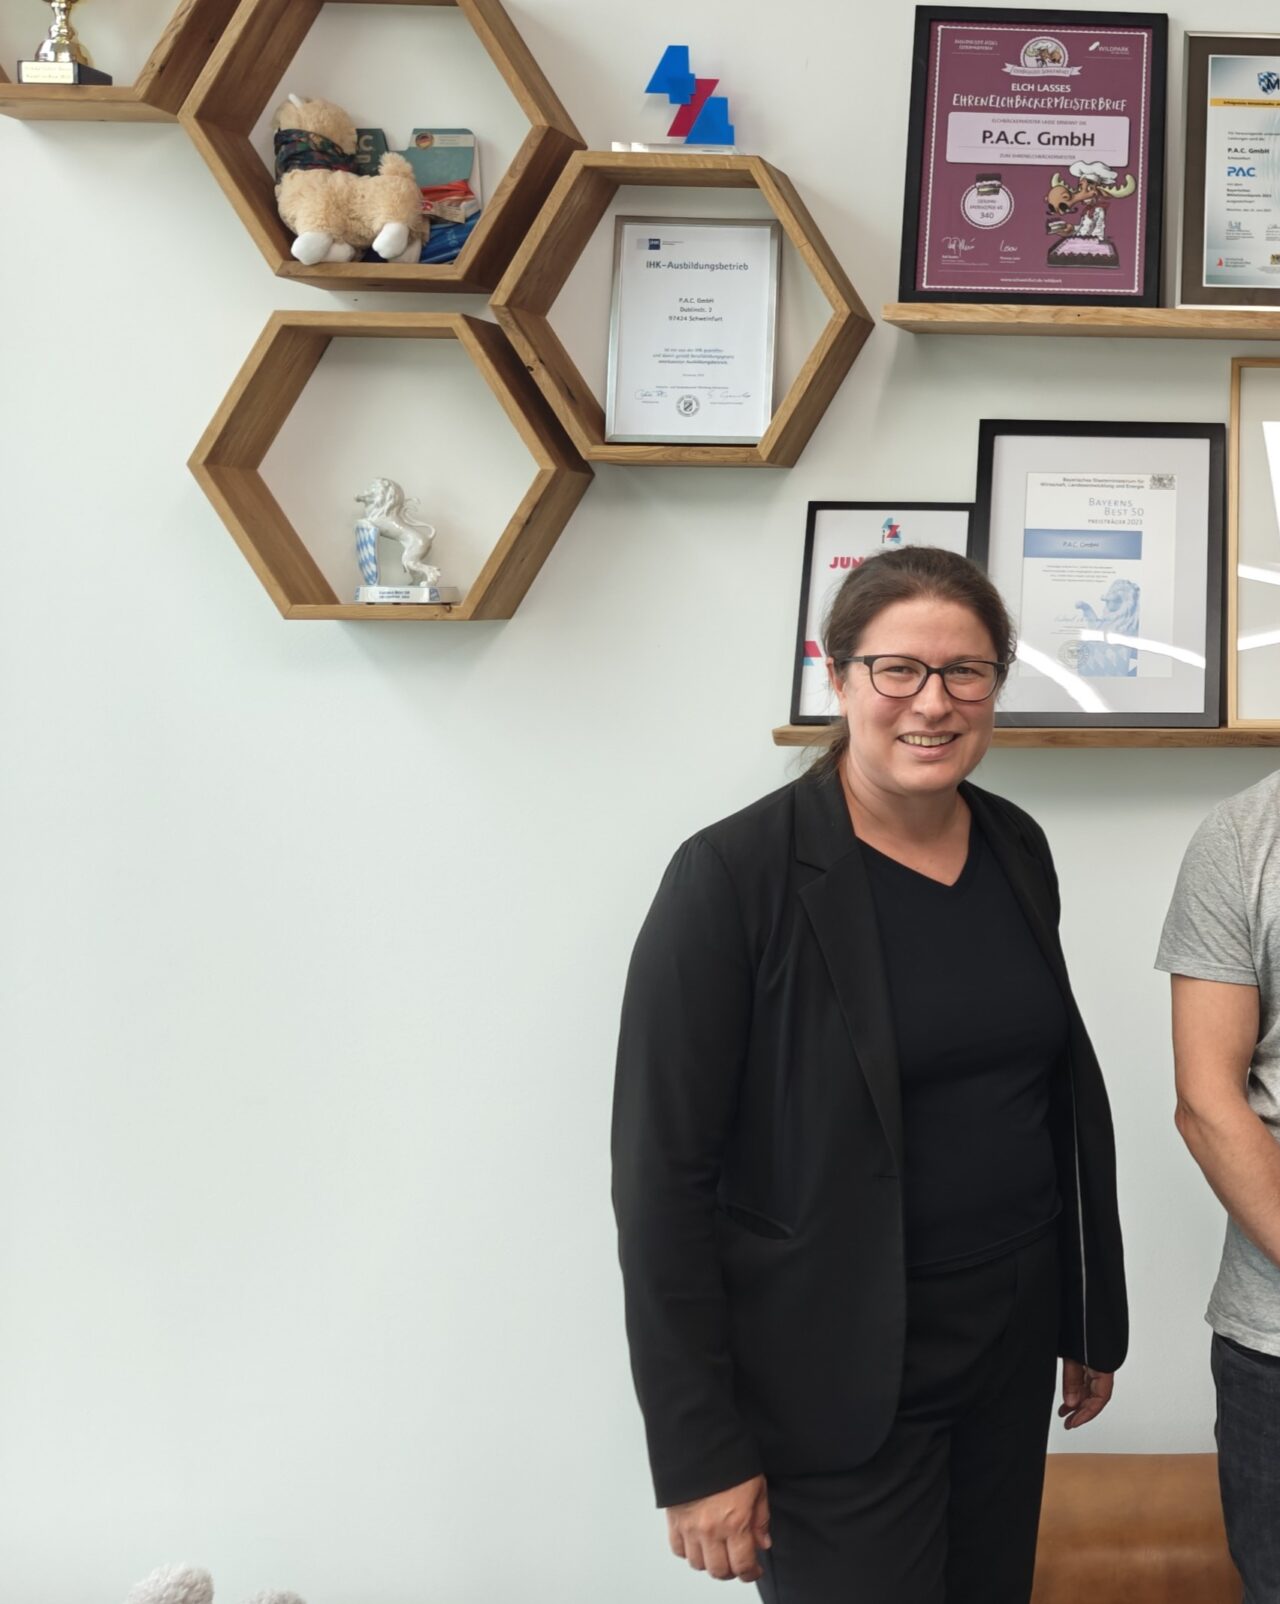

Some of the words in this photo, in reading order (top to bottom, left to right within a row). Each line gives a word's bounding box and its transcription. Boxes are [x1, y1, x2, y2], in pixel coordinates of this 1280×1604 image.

[1011, 83, 1035, 92] ELCH
[1037, 83, 1071, 93] LASSES
[982, 130, 1031, 145] P.A.C.
[1037, 131, 1095, 147] GmbH
[1227, 166, 1256, 177] PAC
[646, 260, 749, 272] IHK-Ausbildungsbetrieb
[1131, 508, 1144, 516] 50
[829, 556, 866, 569] JUN
